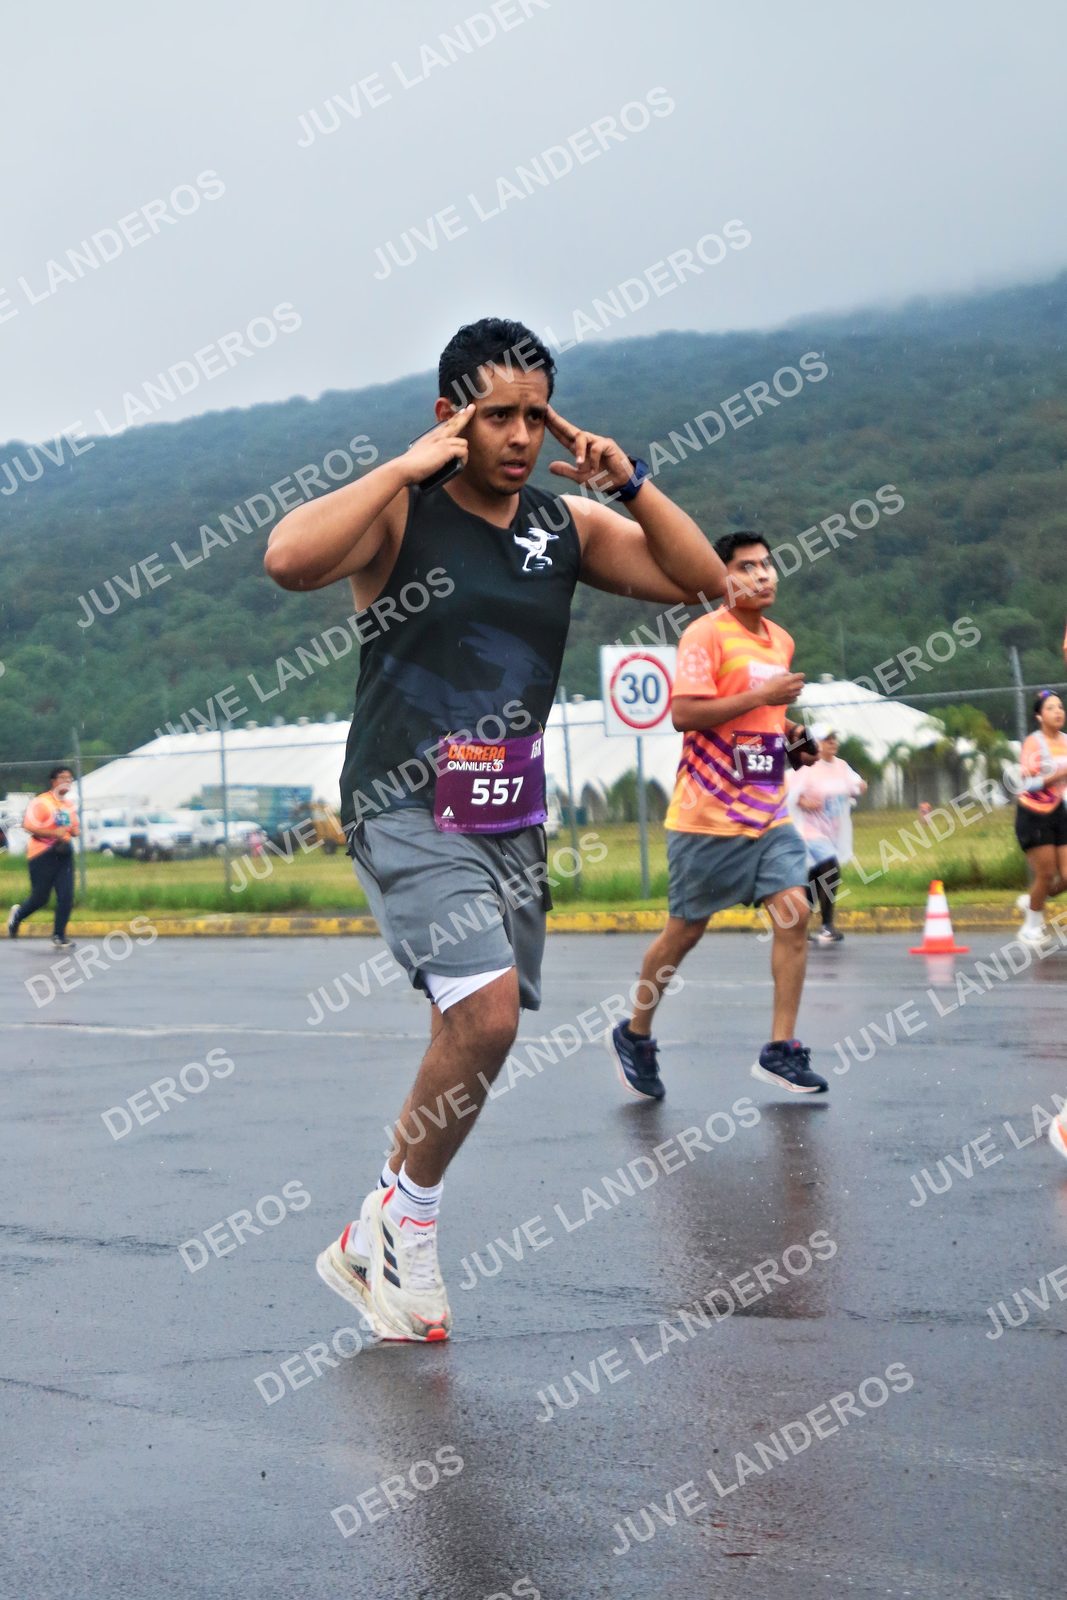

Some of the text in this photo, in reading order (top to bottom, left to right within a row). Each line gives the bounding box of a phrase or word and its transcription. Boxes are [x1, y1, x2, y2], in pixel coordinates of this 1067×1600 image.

[621, 672, 661, 704] 30
[447, 744, 506, 761] CARRERA
[747, 754, 774, 772] 523
[471, 776, 524, 806] 557
